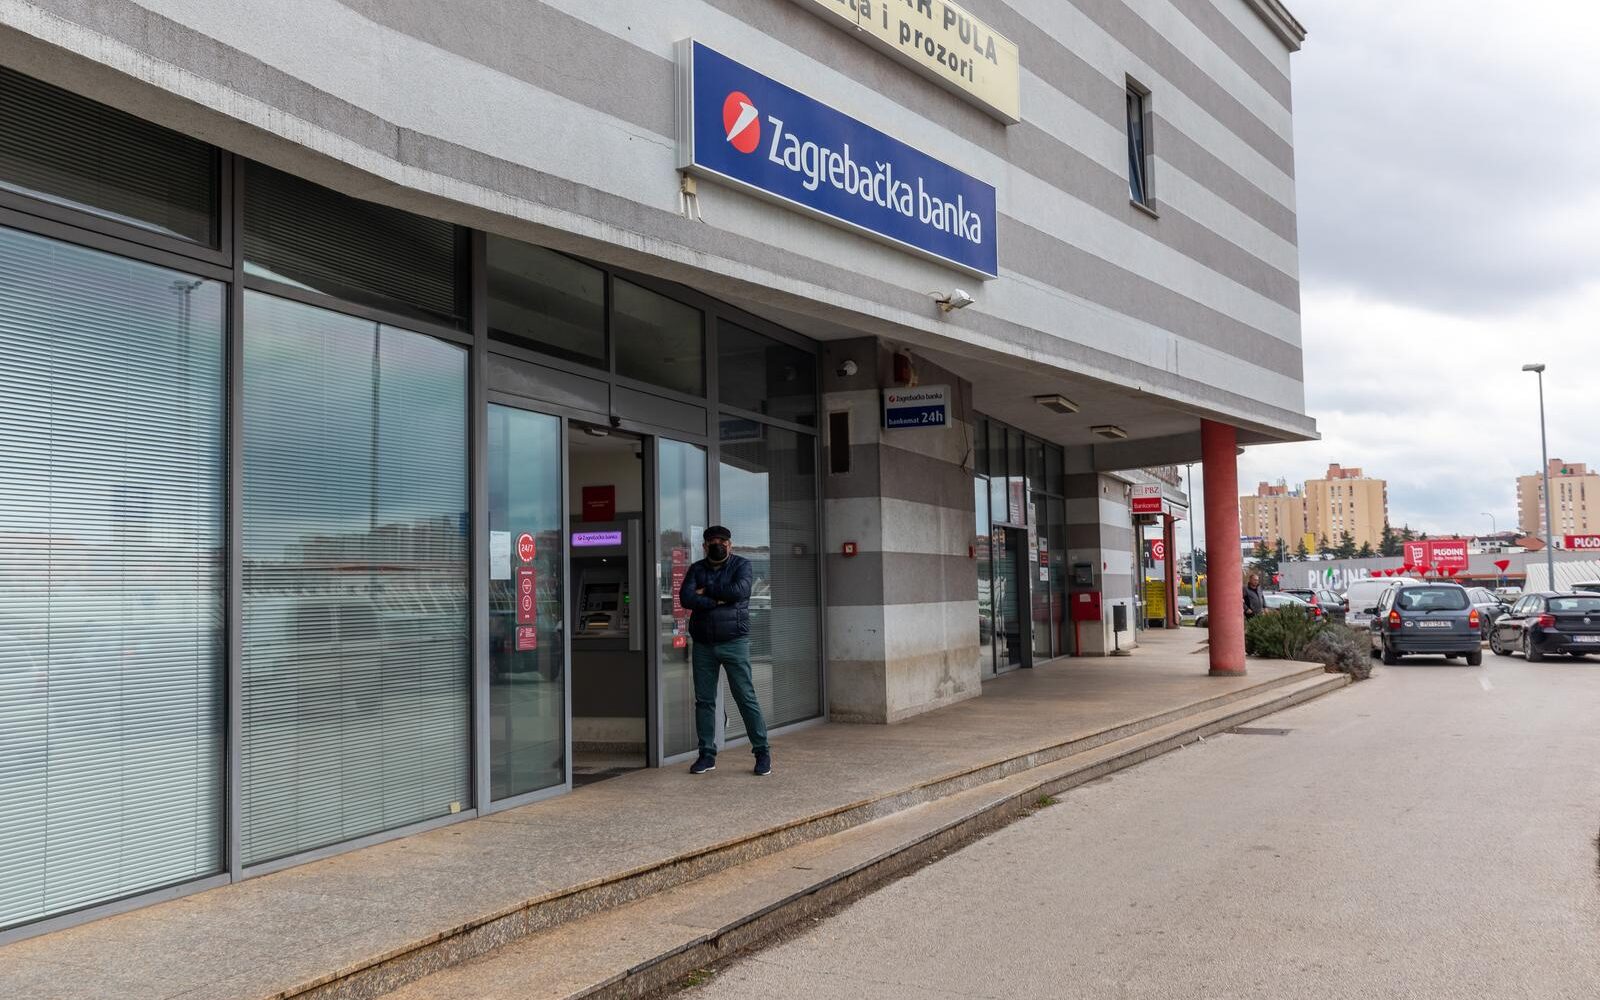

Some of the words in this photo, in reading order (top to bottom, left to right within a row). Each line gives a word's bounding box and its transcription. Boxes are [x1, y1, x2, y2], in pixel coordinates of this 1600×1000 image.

[882, 3, 888, 30] i
[899, 19, 973, 83] prozori
[943, 4, 998, 65] PULA
[768, 115, 914, 217] Zagrebačka
[918, 177, 982, 244] banka
[921, 410, 944, 423] 24h
[521, 543, 534, 553] 24/7
[1433, 548, 1464, 556] PLODINE
